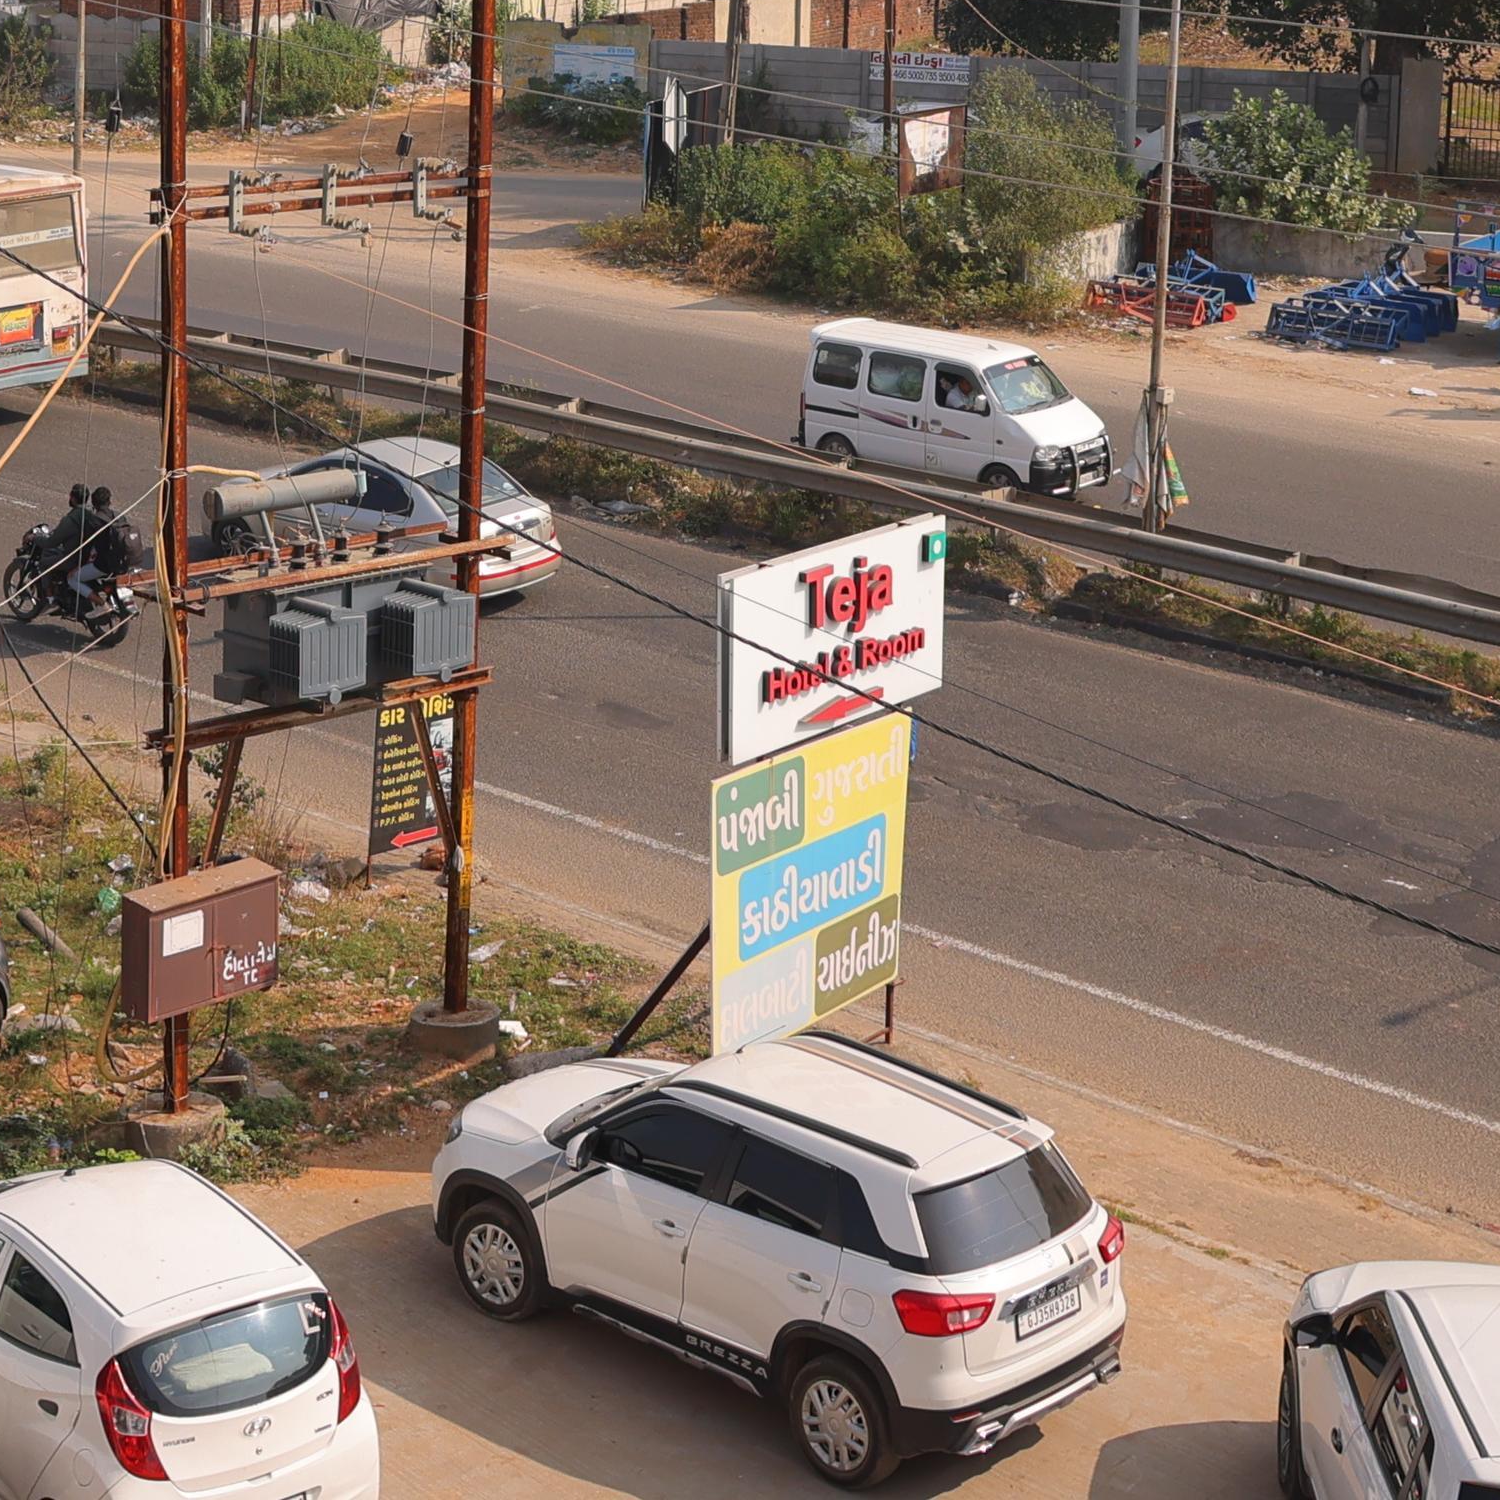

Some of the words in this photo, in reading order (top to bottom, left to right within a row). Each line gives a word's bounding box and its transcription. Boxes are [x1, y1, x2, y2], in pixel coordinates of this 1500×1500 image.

[799, 556, 893, 633] Teja
[762, 652, 830, 703] Hotel
[831, 645, 853, 677] &
[855, 627, 925, 671] Room
[380, 707, 405, 727] કાર
[718, 769, 800, 852] પંજાબી
[812, 724, 903, 827] ગુજરાતી
[741, 828, 881, 946] કાઠીયાવાડી
[243, 968, 258, 985] TC
[720, 947, 808, 1049] દાલબાટી
[1027, 1293, 1076, 1328] GJ35H9328
[686, 1334, 768, 1379] BREZZA
[162, 1436, 196, 1447] HYUNDAI
